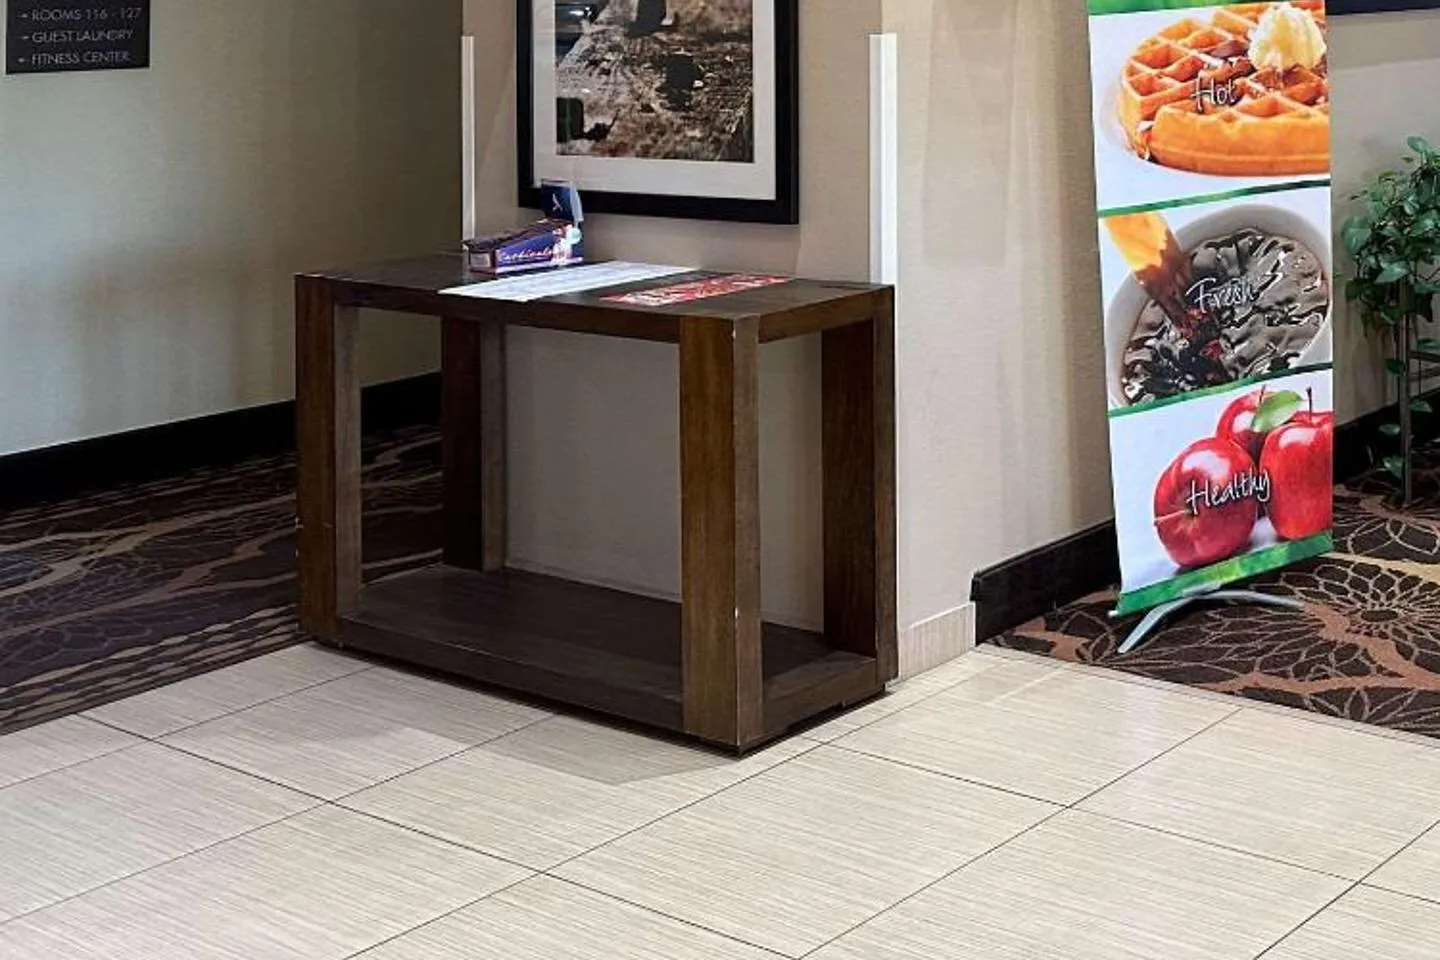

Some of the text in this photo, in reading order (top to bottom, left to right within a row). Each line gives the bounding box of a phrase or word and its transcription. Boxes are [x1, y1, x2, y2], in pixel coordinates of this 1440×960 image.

[31, 8, 82, 22] ROOMS
[31, 28, 134, 44] GUEST LAUNDRY
[31, 50, 132, 66] FITNESS CENTER
[1190, 70, 1236, 111] Hot
[1185, 277, 1256, 314] Fresh
[1185, 466, 1272, 516] Healthy
